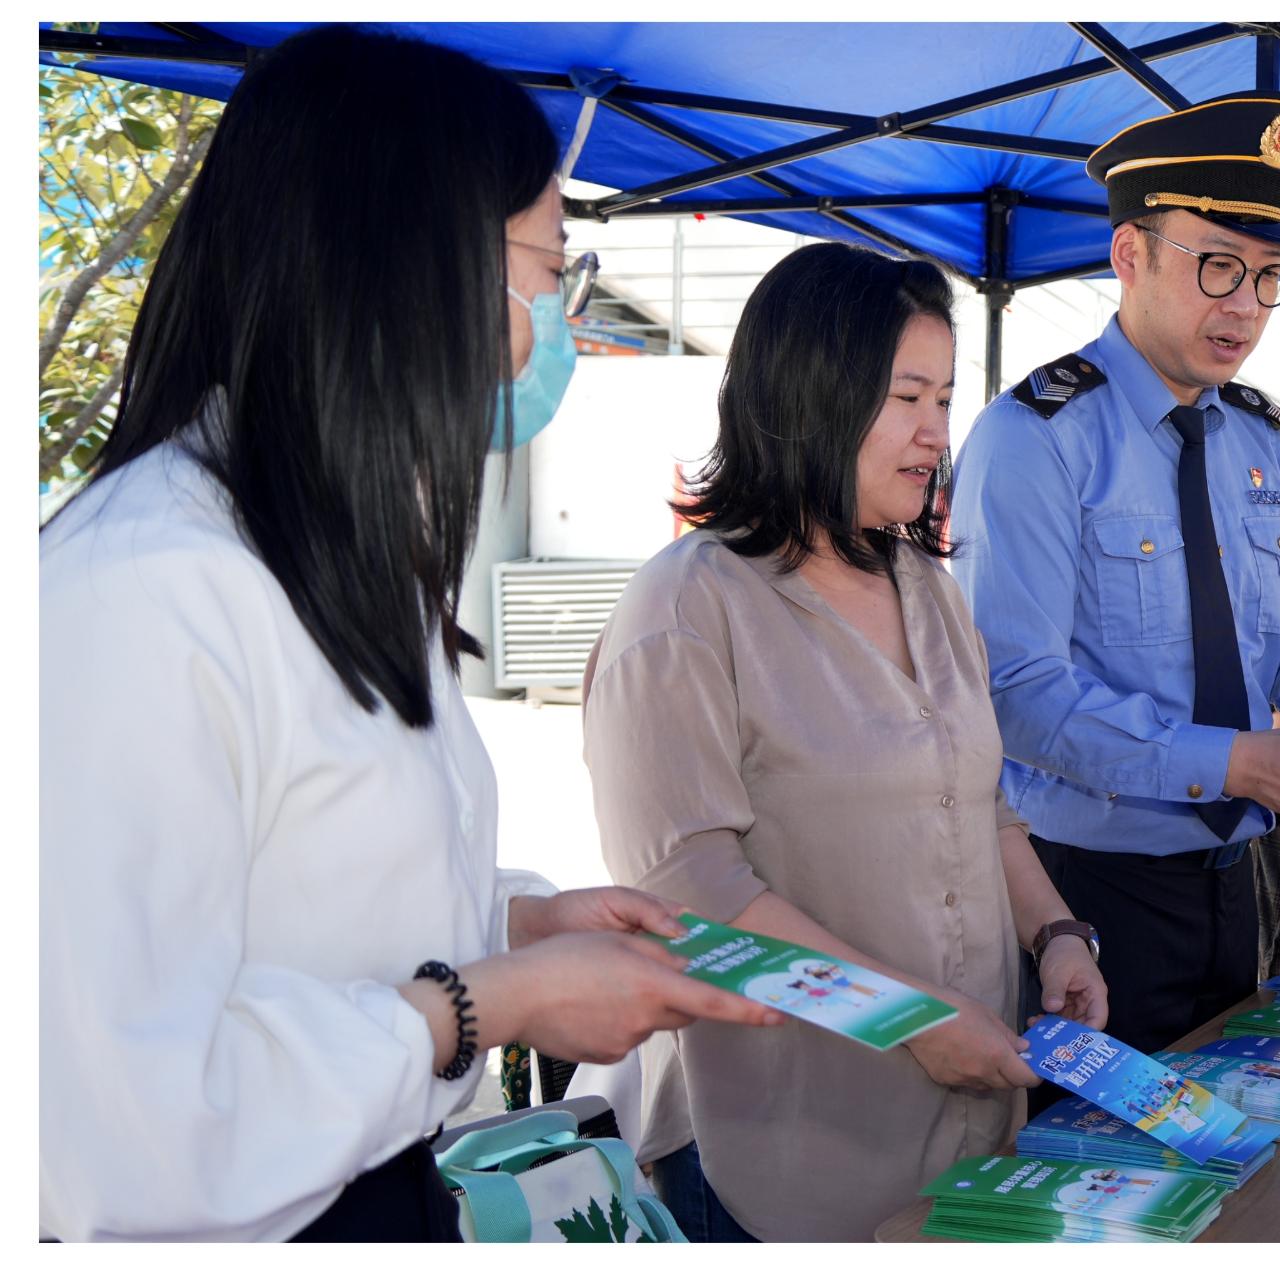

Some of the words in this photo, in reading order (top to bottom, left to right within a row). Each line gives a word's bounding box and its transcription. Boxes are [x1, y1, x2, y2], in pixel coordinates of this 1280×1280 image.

[1039, 1032, 1095, 1074] 科学运动
[1064, 1040, 1120, 1088] 避开误区
